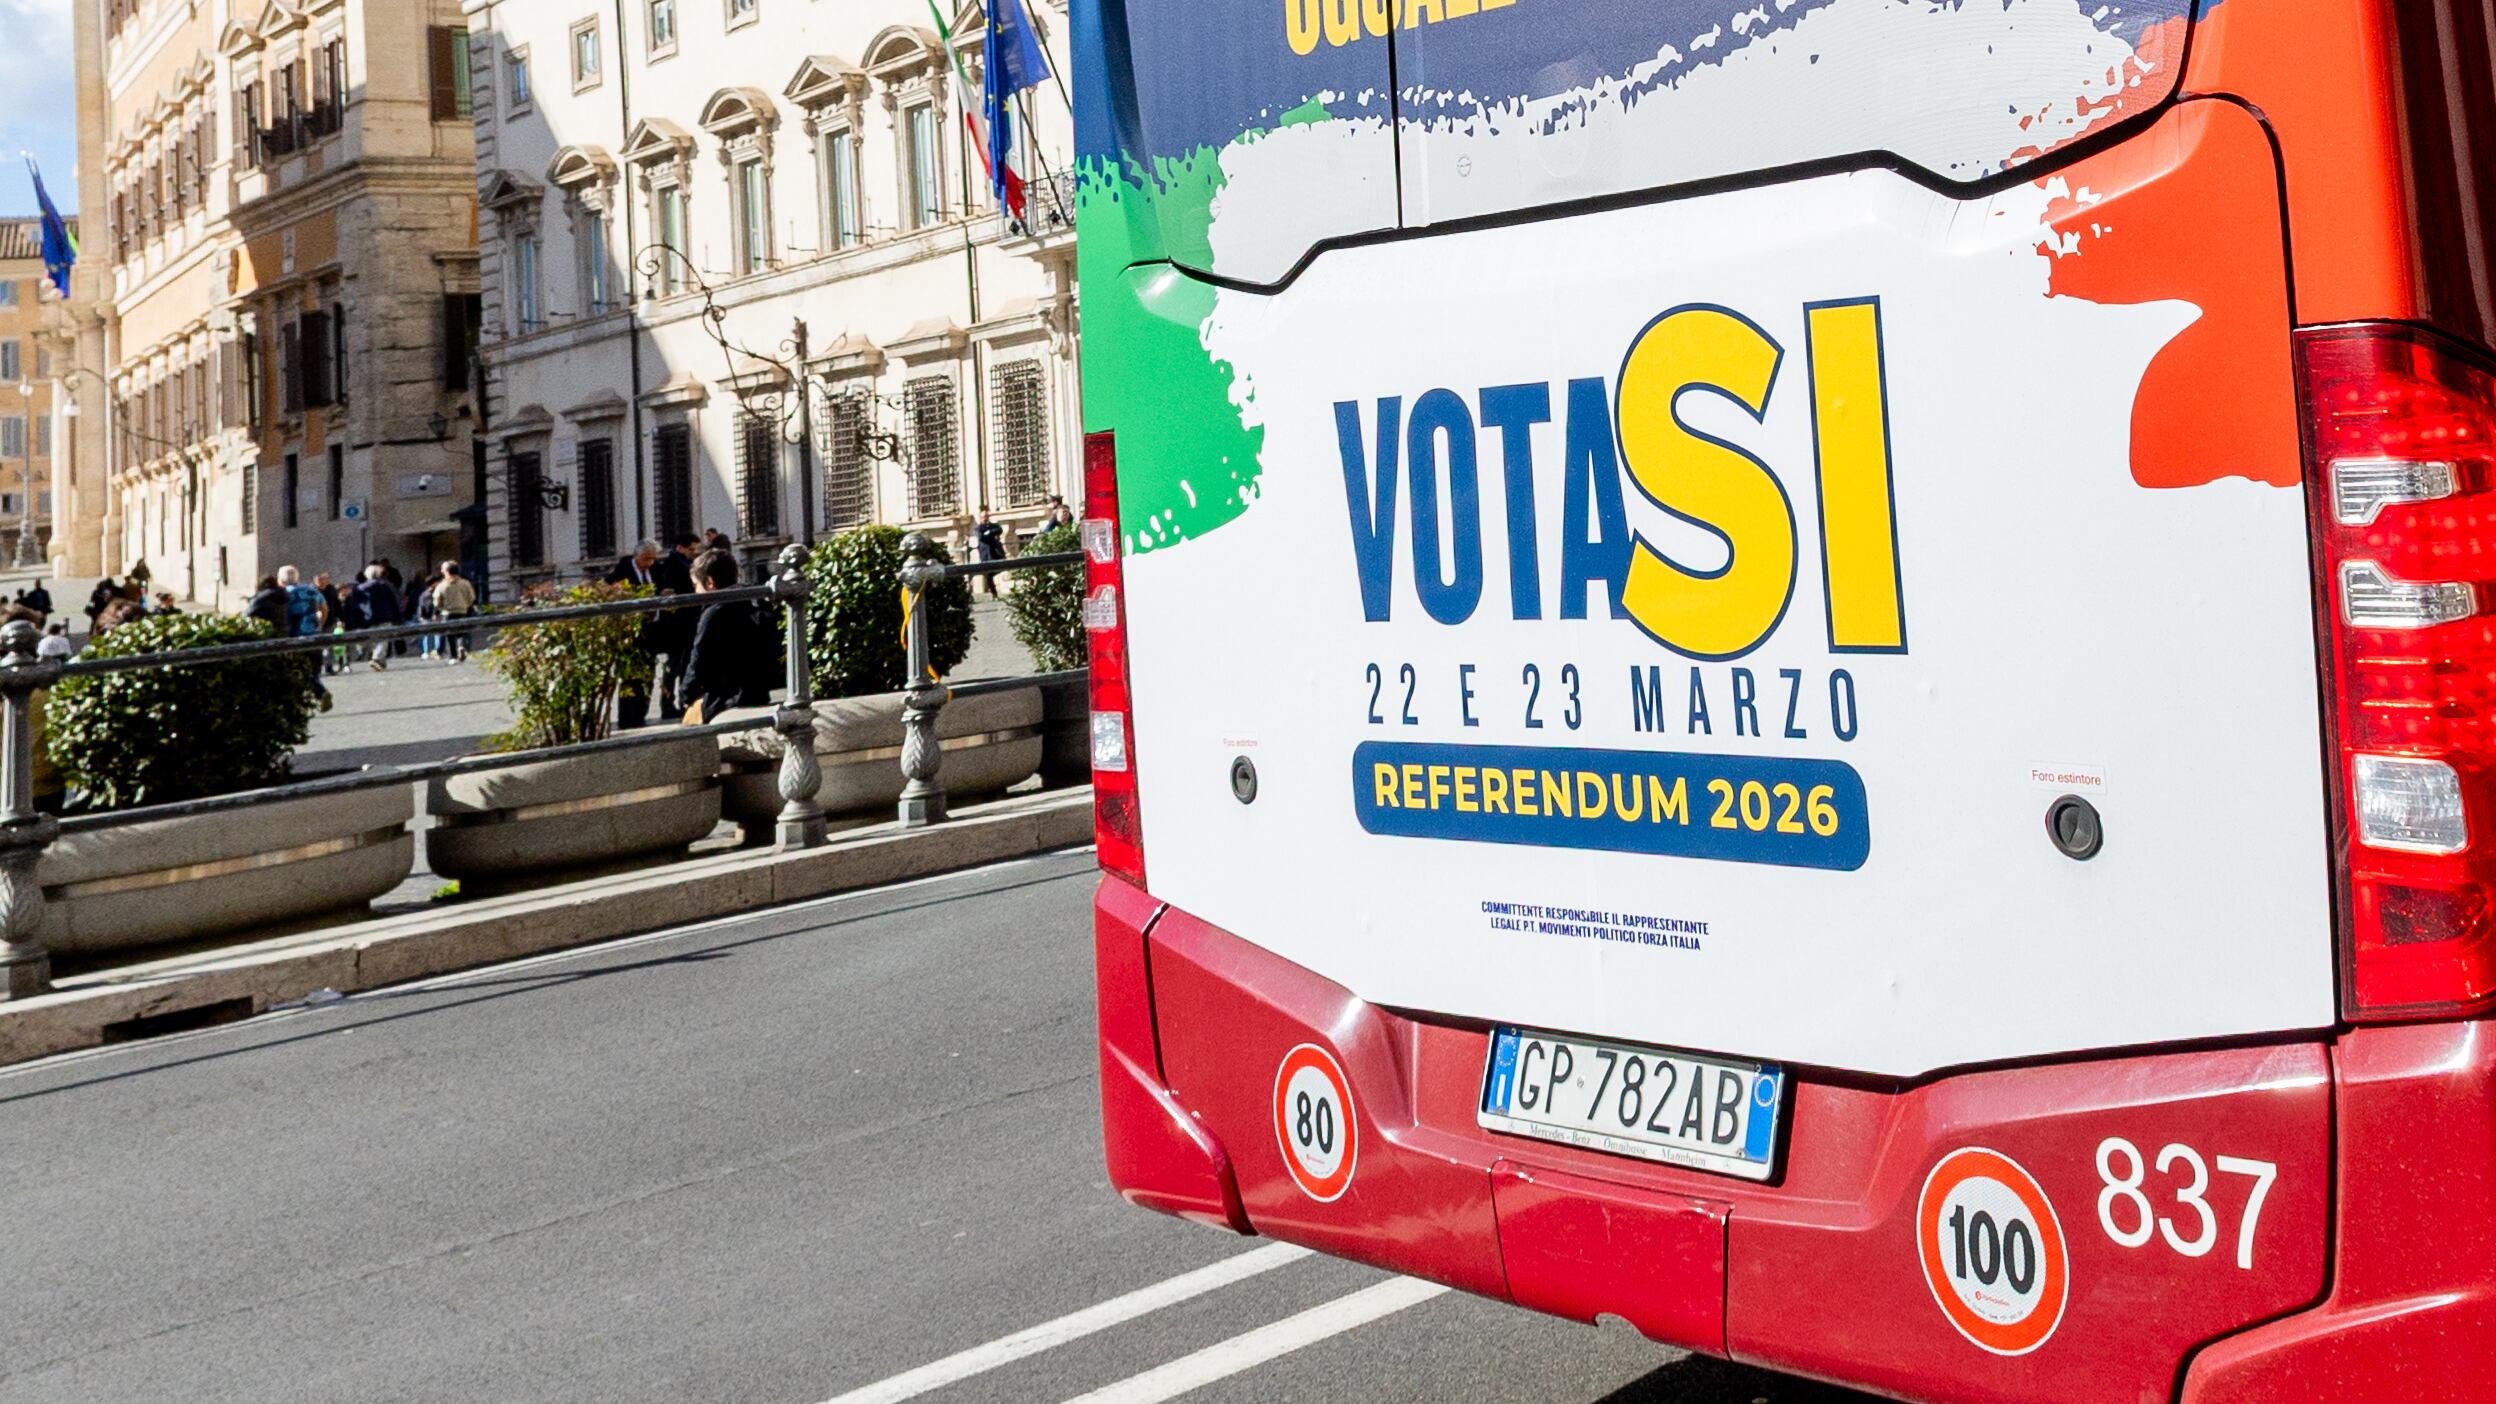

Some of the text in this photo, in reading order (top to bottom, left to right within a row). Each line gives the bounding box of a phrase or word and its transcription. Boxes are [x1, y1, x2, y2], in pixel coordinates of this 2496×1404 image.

[1333, 294, 1909, 662] VOTA SI
[1365, 662, 1859, 742] 22 E 23 MARZO
[1373, 762, 1840, 837] REFERENDUM 2026
[2031, 769, 2102, 786] Foro estintore
[1481, 901, 1544, 918] COMMITTENTE
[1611, 912, 1621, 926] IL
[1622, 914, 1710, 936] RAPPRESENTANTE
[1490, 917, 1701, 951] LEGALE P.T. MOVIMENTI POLITICO FORZA ITALIA
[1297, 1090, 1334, 1154] 80
[1518, 1040, 1743, 1145] GP 782AB
[2096, 1136, 2277, 1270] 837
[1949, 1205, 2036, 1294] 100
